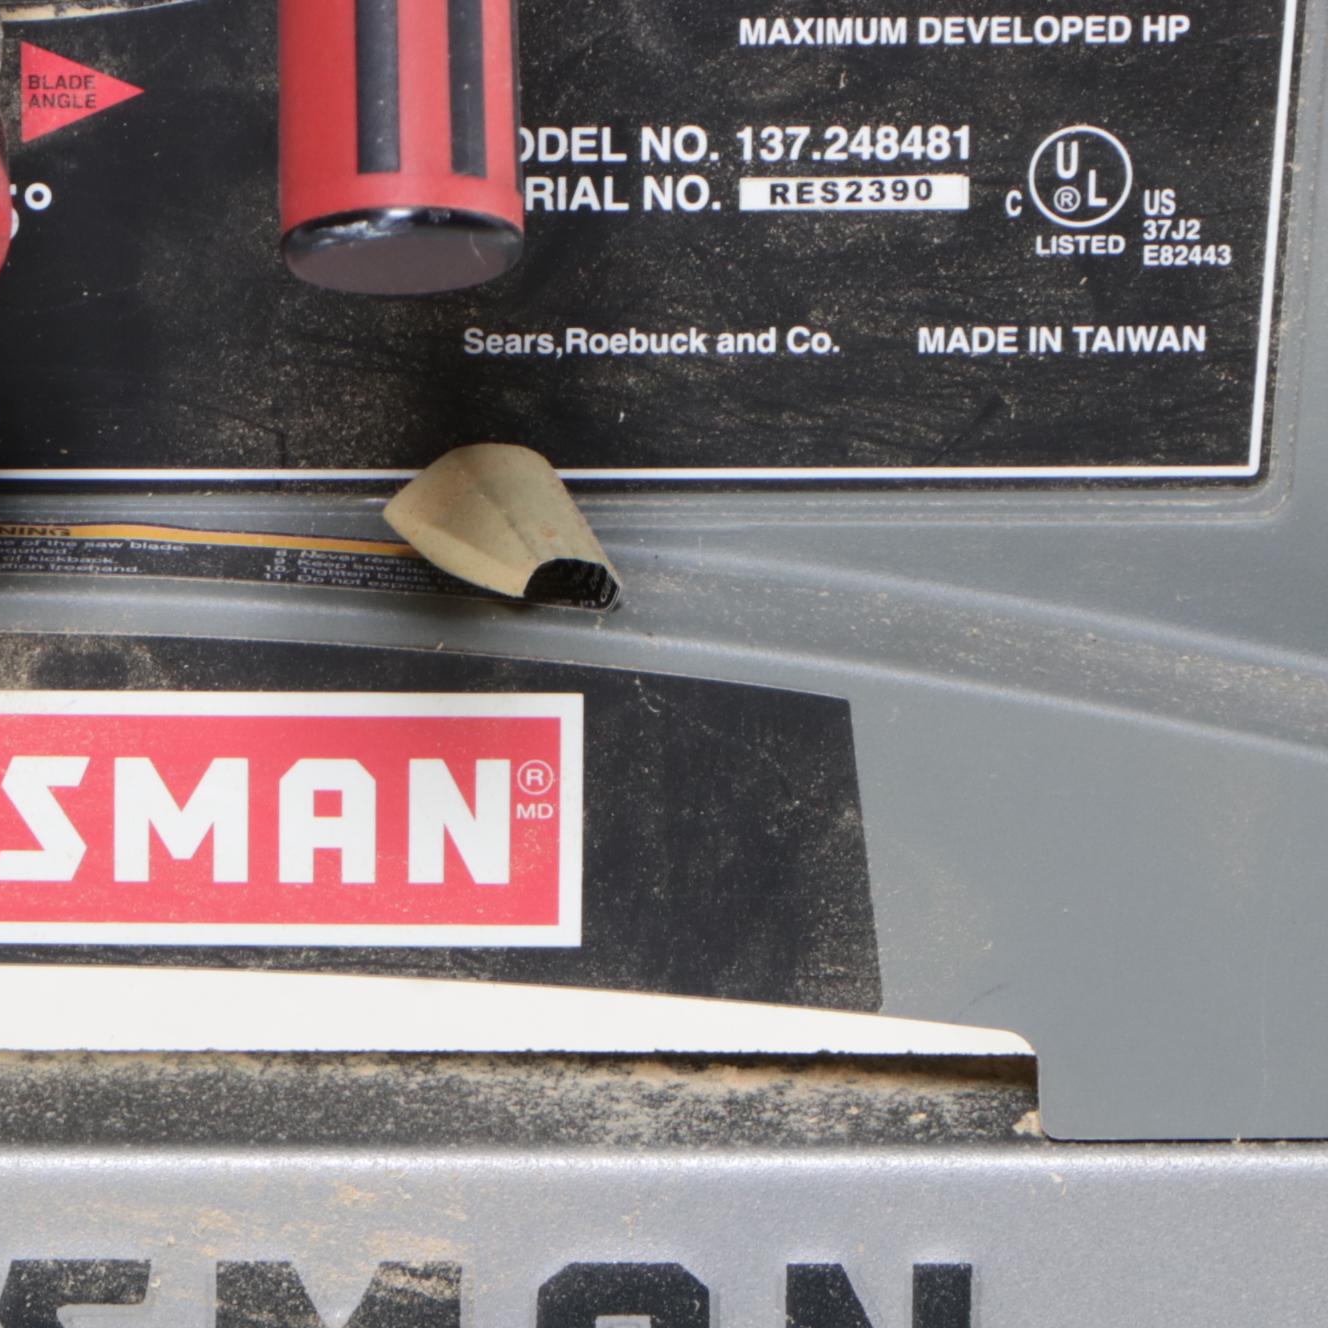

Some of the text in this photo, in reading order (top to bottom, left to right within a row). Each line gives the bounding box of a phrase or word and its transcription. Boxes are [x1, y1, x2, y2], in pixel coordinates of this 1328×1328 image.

[738, 14, 1193, 46] MAXIMUM DEVELOPED HP
[27, 75, 97, 90] BLADE
[27, 94, 98, 108] ANGLE
[519, 124, 971, 163] DEL NO. 137.248481
[524, 174, 936, 211] RIAL NO. RES2390
[1143, 188, 1177, 217] US
[1142, 218, 1202, 241] 37J2
[1035, 234, 1126, 256] LISTED
[1142, 244, 1232, 268] E82443
[715, 327, 777, 354] and
[785, 326, 841, 354] Co.
[917, 325, 1207, 354] MADE IN TAIWAN
[516, 802, 554, 820] MD
